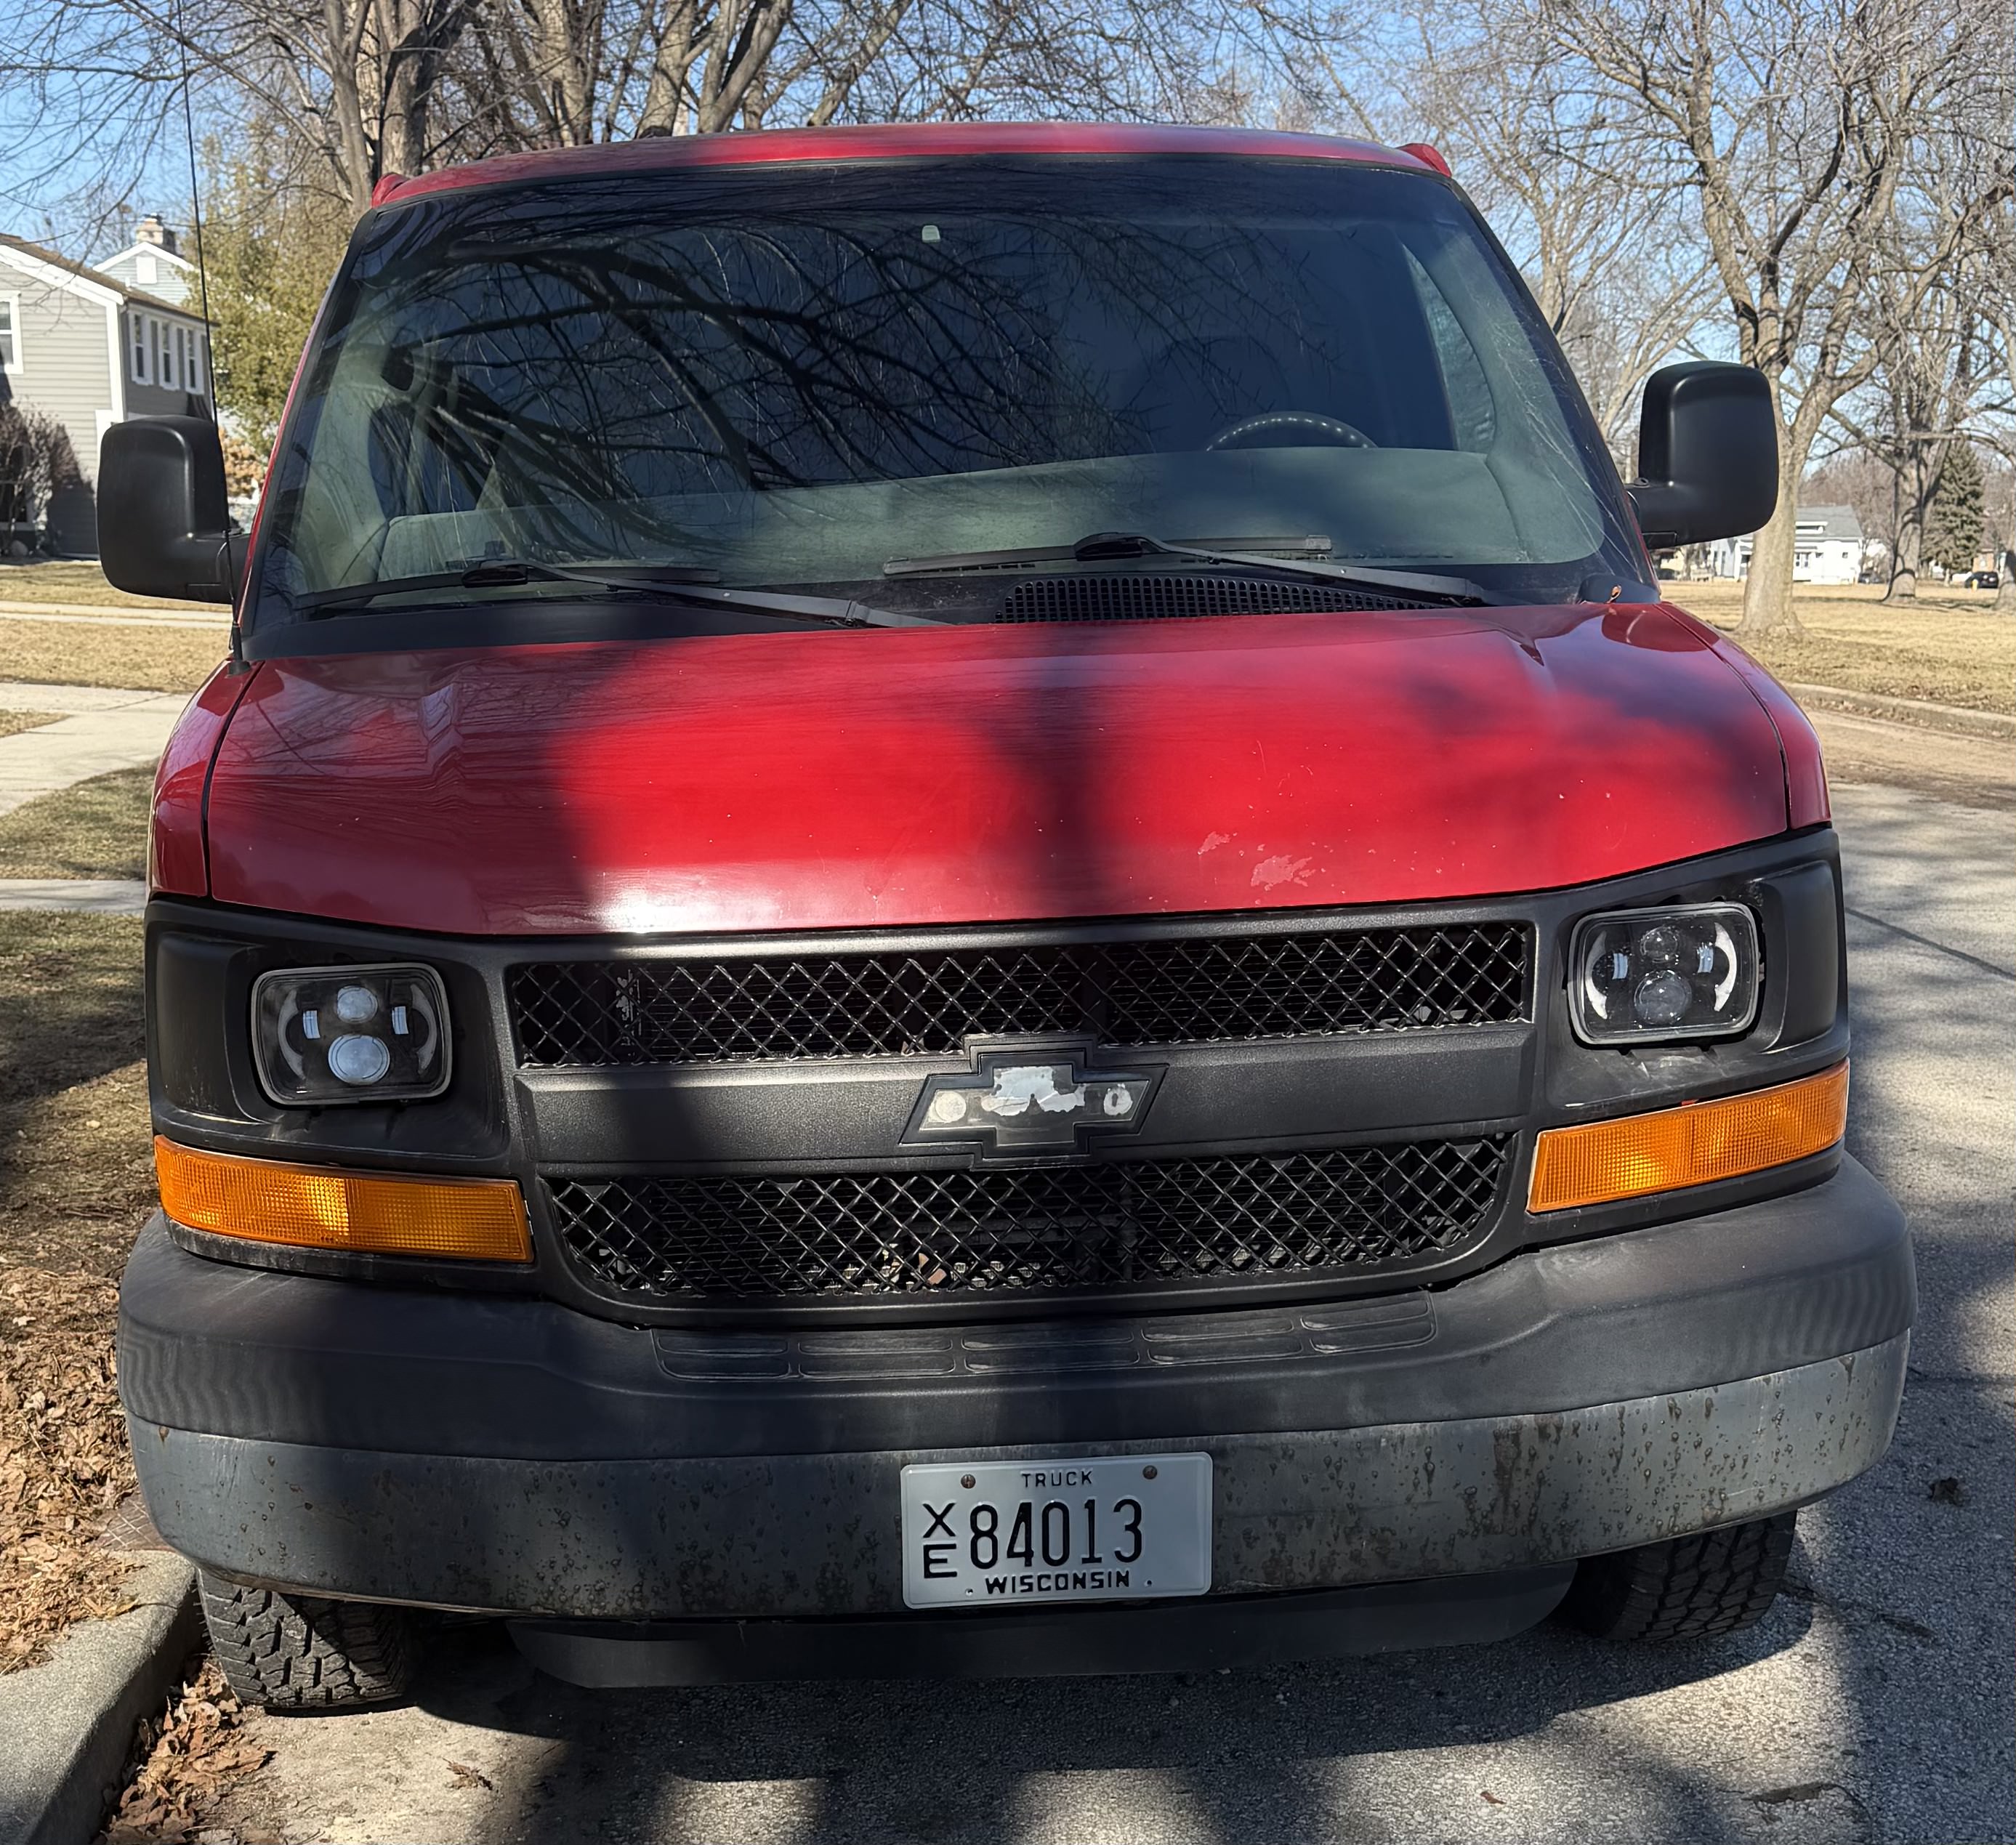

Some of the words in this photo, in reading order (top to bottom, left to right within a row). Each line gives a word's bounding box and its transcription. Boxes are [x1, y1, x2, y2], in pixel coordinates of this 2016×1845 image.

[1023, 1471, 1093, 1487] TRUCK
[969, 1498, 1142, 1570] 84013
[985, 1570, 1129, 1594] WISCONSIN
